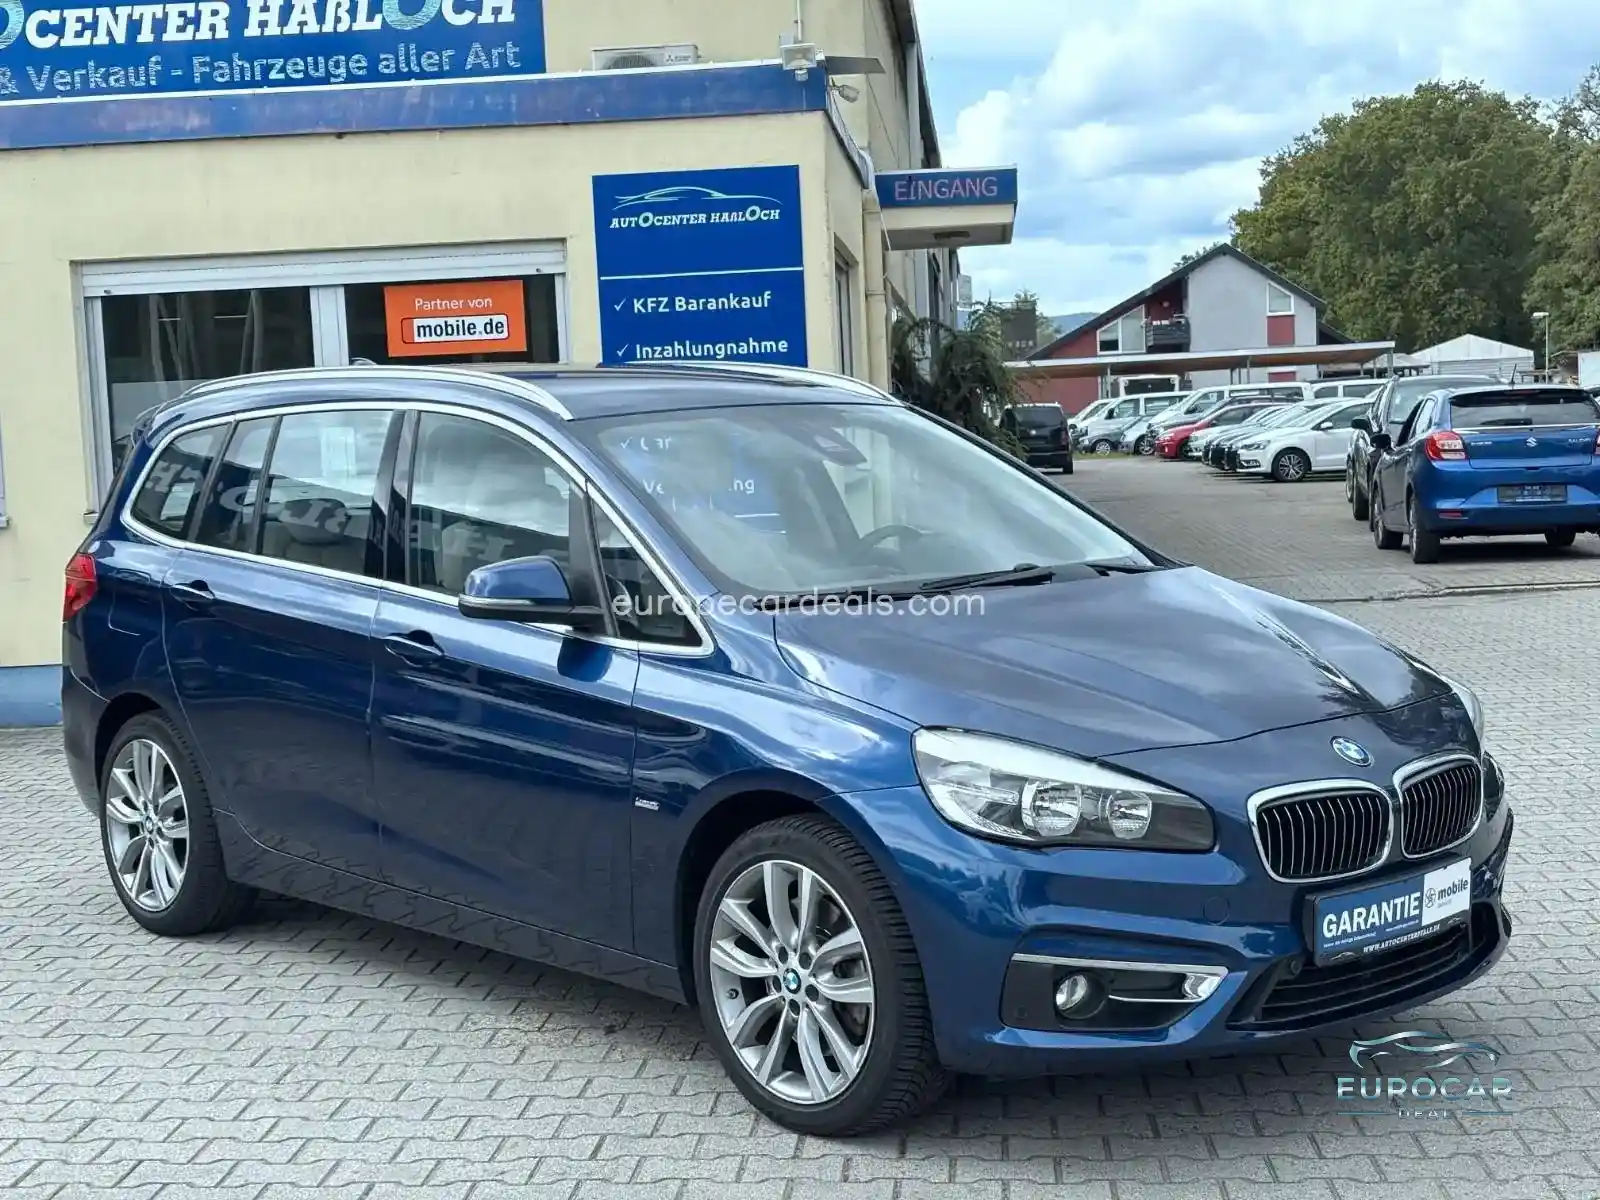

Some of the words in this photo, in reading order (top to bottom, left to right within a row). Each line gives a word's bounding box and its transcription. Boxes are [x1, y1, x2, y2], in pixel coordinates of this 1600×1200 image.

[26, 55, 162, 92] Verkauf
[192, 52, 368, 84] Fahrzeuge
[378, 43, 455, 74] aller
[465, 41, 521, 71] Art
[894, 176, 998, 201] EINGANG
[610, 211, 707, 229] AUTOCENTER
[415, 298, 464, 312] Partner
[467, 297, 493, 309] von
[633, 296, 670, 314] KFZ
[674, 290, 772, 312] Barankauf
[416, 318, 505, 338] mobile.de
[635, 337, 788, 359] Inzahlungnahme
[1437, 877, 1469, 901] mobile
[1322, 891, 1421, 938] GARANTIE
